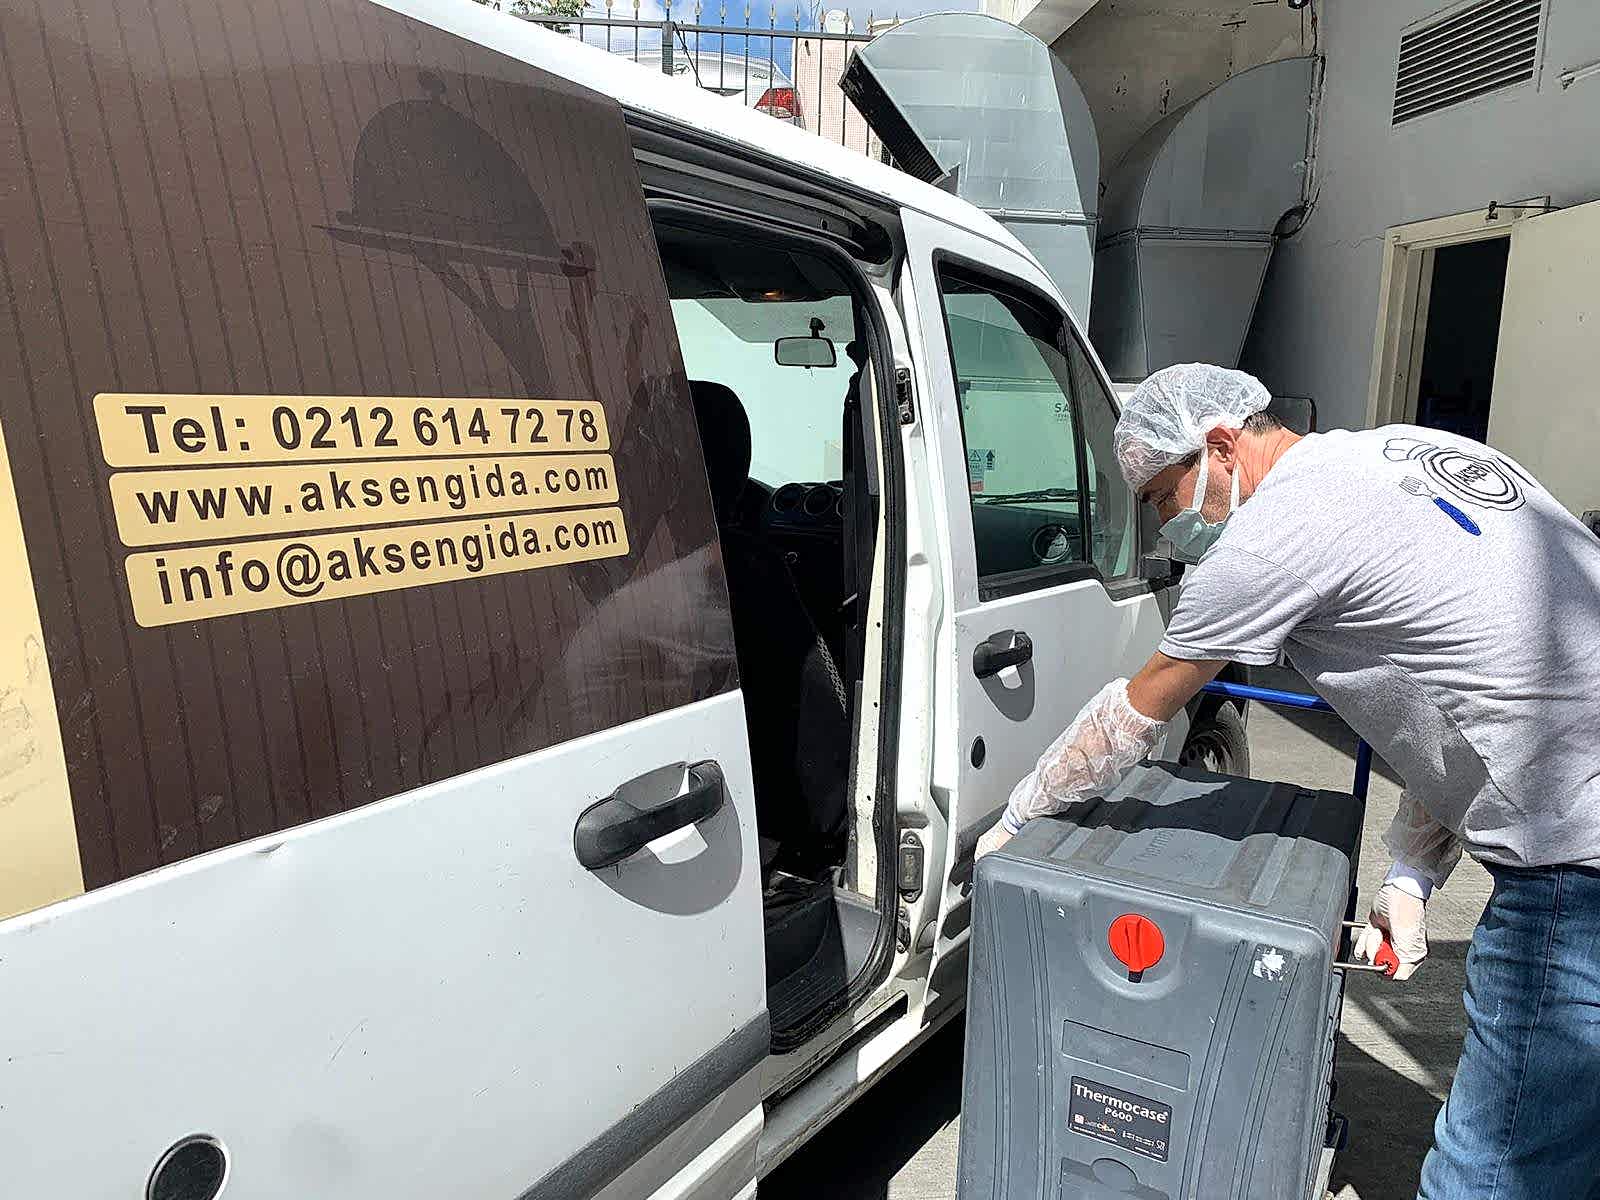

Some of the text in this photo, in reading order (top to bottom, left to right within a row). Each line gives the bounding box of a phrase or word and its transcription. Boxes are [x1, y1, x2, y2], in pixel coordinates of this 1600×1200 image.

[125, 406, 598, 454] Tel: 0212 614 72 78
[136, 463, 609, 525] www.aksengida.com
[156, 520, 618, 605] info@aksengida.com
[1104, 1106, 1133, 1123] P600
